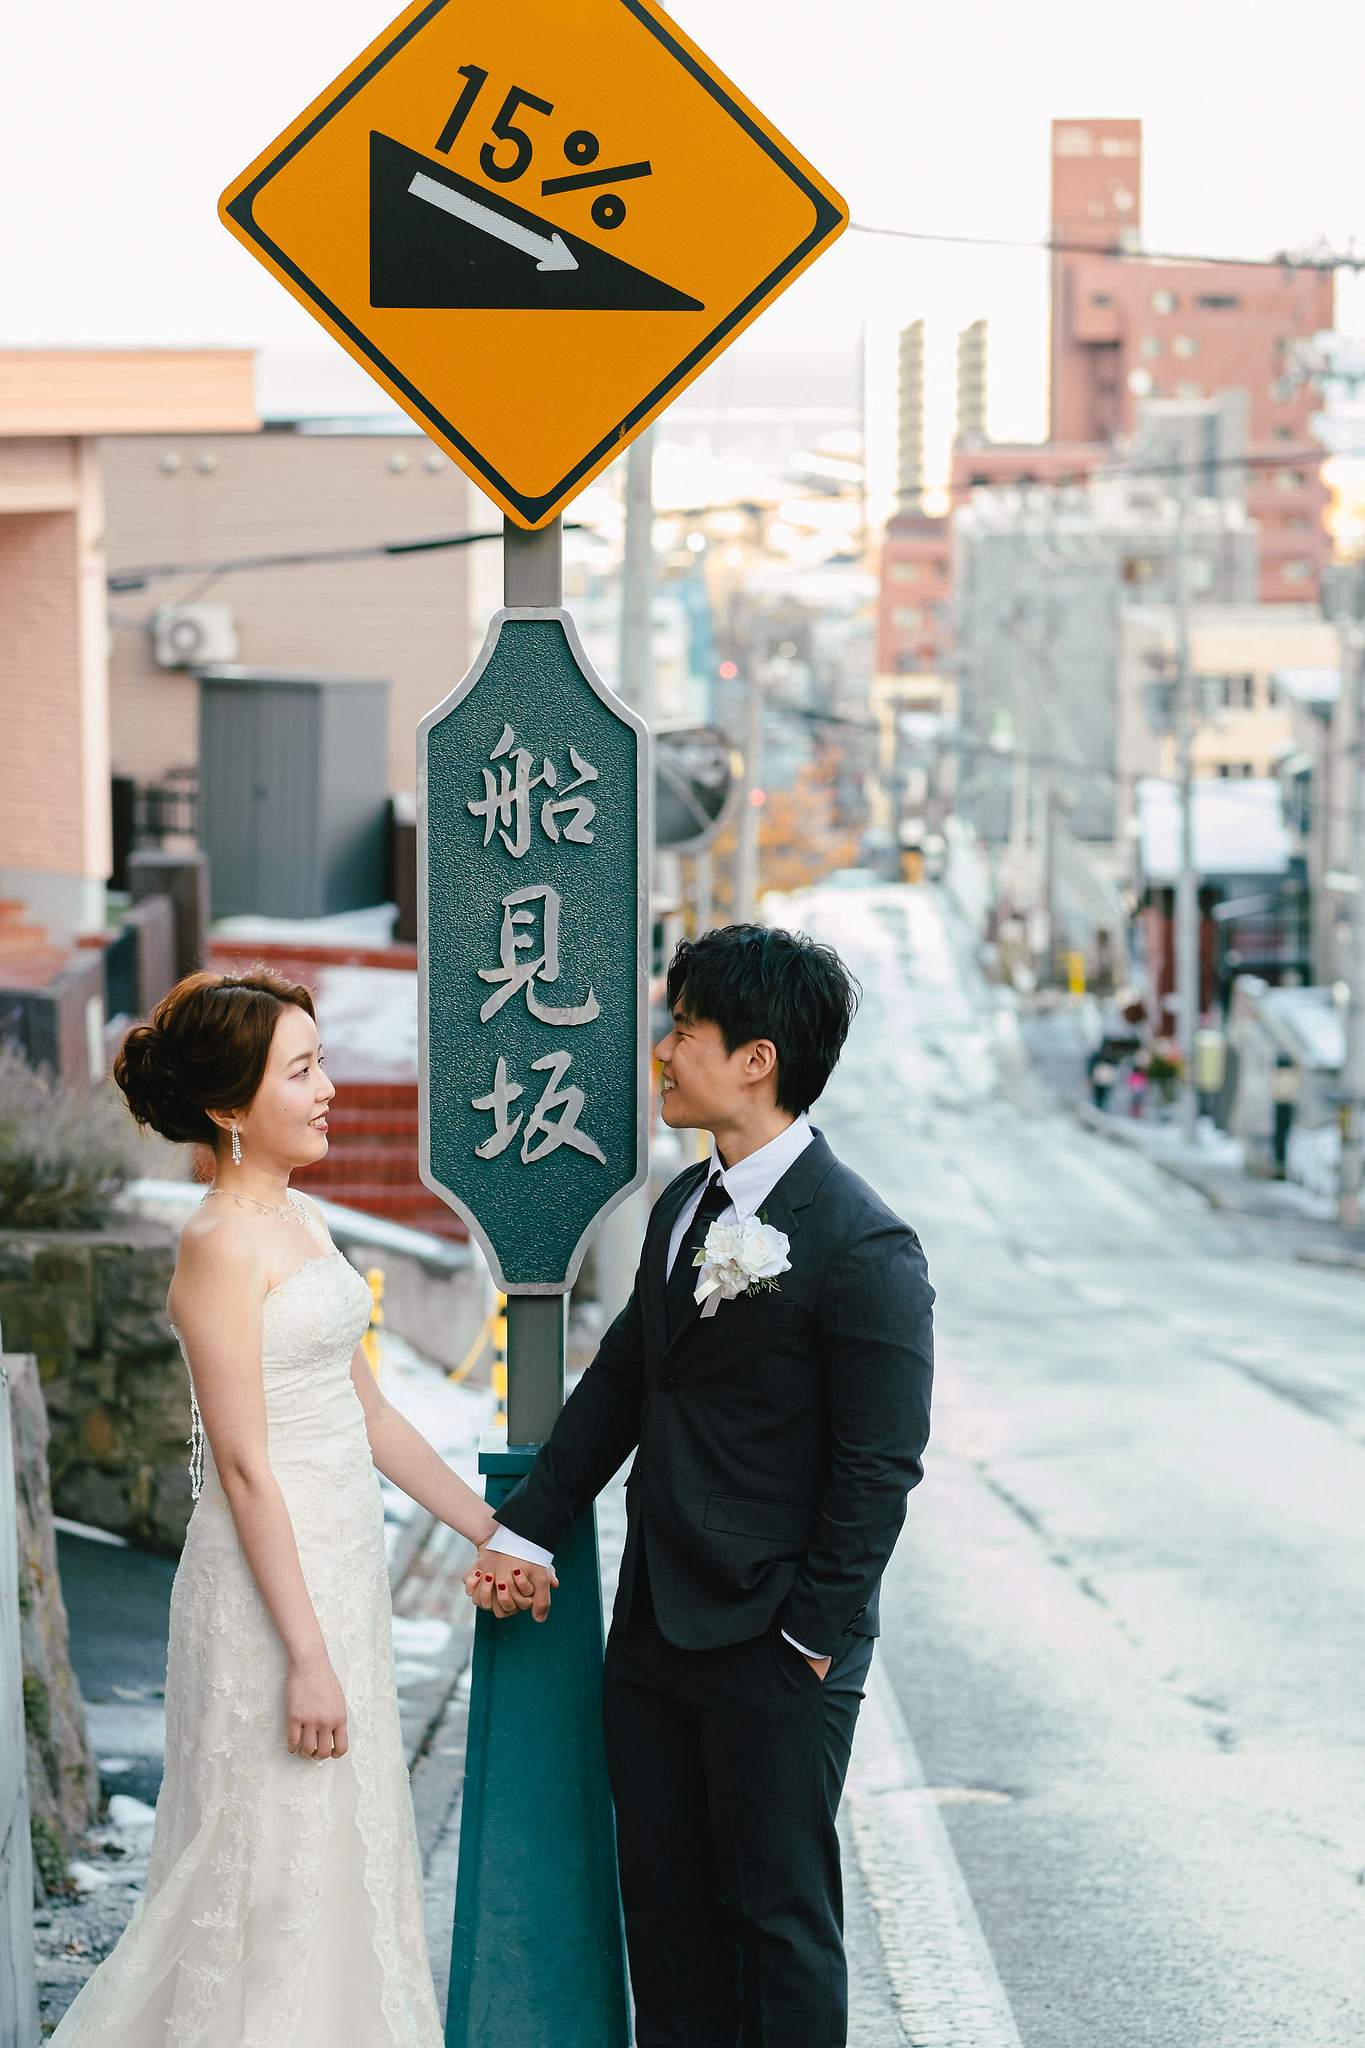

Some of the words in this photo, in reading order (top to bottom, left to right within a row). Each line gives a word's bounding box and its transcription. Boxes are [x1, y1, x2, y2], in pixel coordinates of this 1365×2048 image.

[435, 64, 652, 229] 15%
[467, 724, 606, 1166] 船見坂
